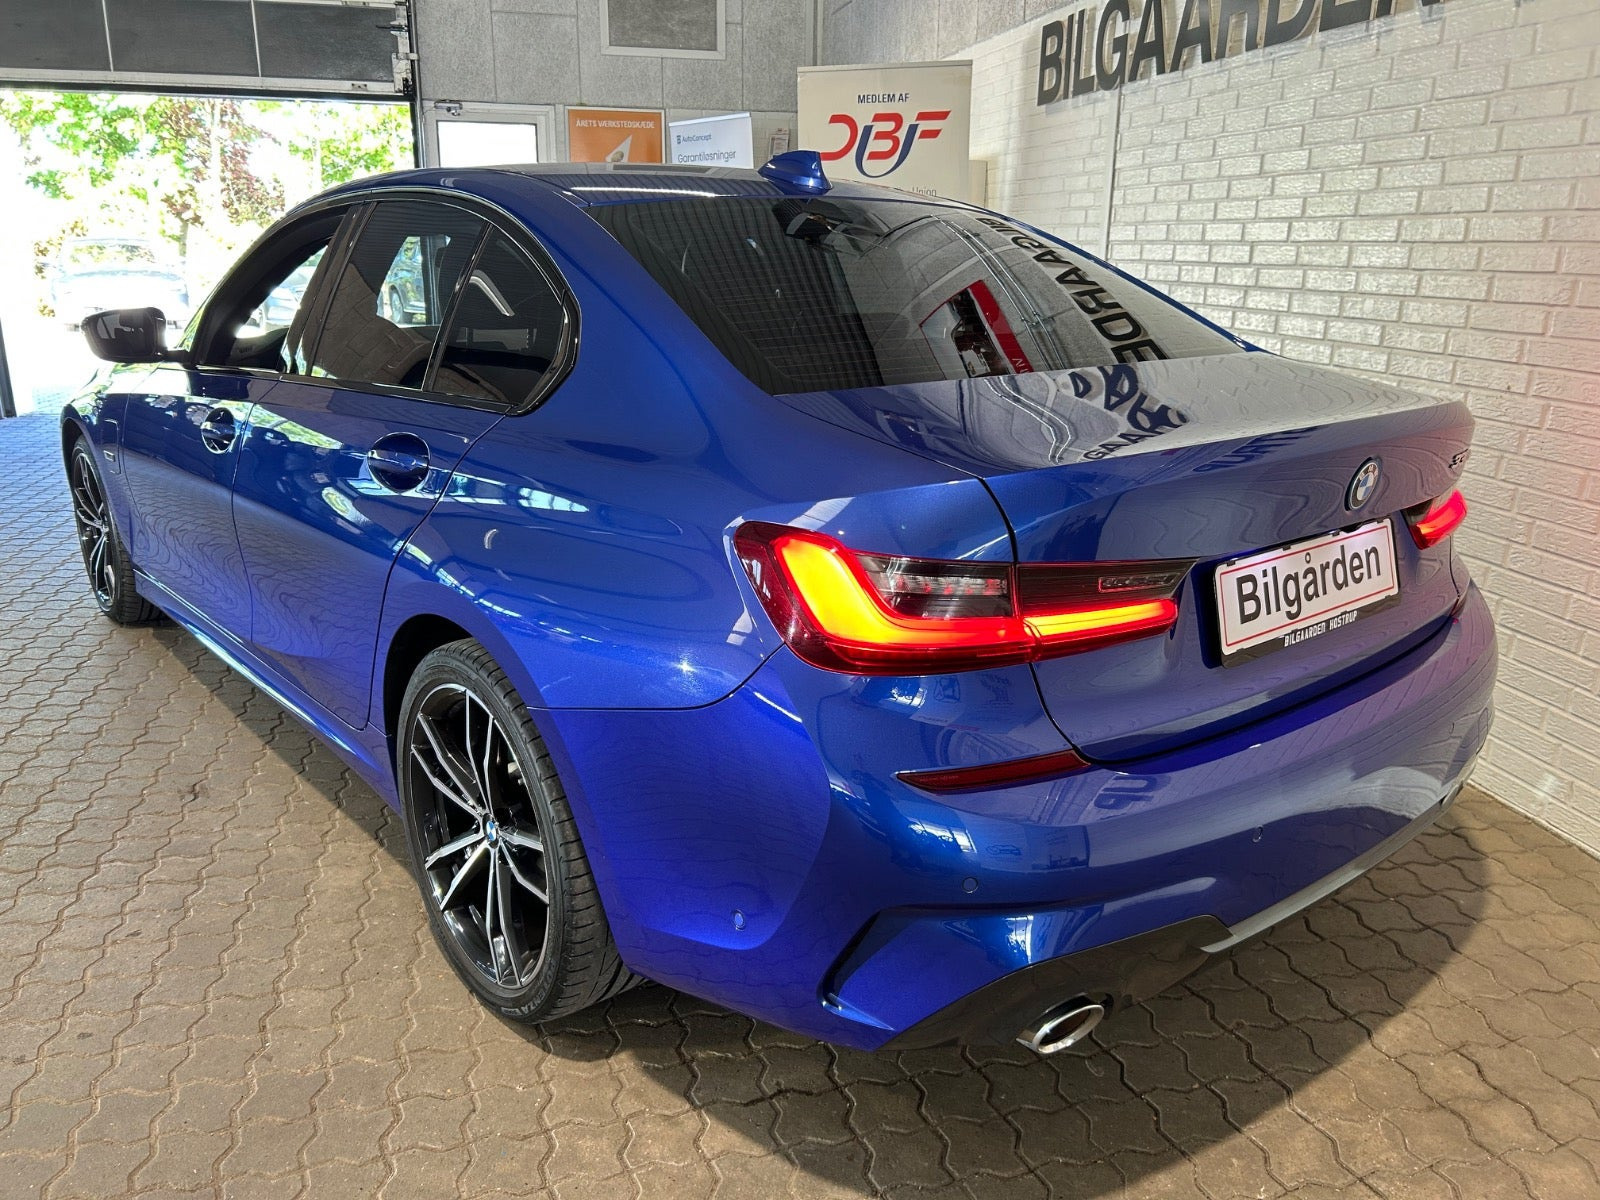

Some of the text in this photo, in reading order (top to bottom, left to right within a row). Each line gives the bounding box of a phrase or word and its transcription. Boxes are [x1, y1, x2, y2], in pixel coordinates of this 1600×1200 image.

[1037, 0, 1441, 106] BILGAAR
[857, 92, 910, 104] MEDLEM AF
[576, 118, 596, 127] ÅRETS
[681, 133, 712, 143] AutoConcept
[1236, 544, 1381, 625] Bilgården
[1284, 610, 1358, 647] BILGAARDEN HOSTRUP
